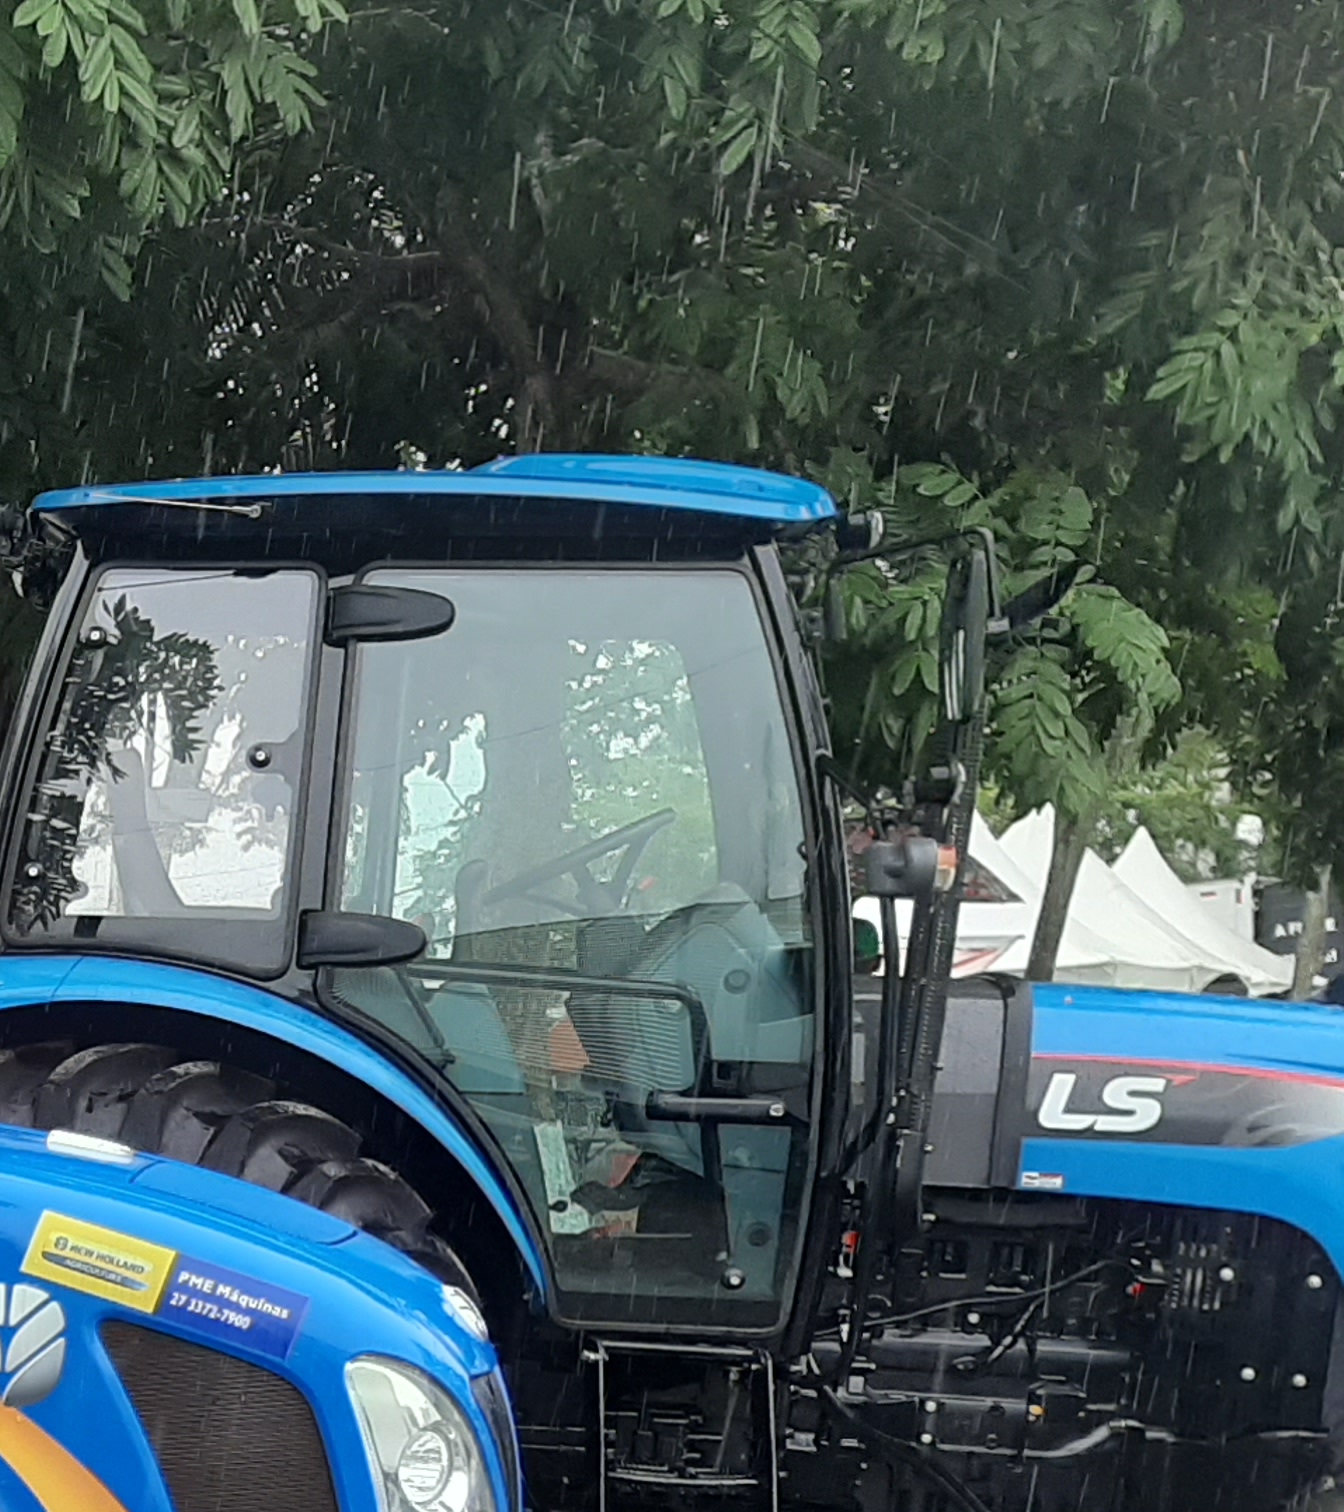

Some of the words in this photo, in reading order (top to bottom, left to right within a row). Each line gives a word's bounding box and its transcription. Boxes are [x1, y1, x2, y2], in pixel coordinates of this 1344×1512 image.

[1038, 1072, 1167, 1133] LS
[69, 1241, 94, 1259] NEW
[95, 1251, 145, 1274] HOLLAND
[170, 1292, 187, 1306] 27
[178, 1271, 214, 1294] PME
[216, 1283, 290, 1320] Máquinas
